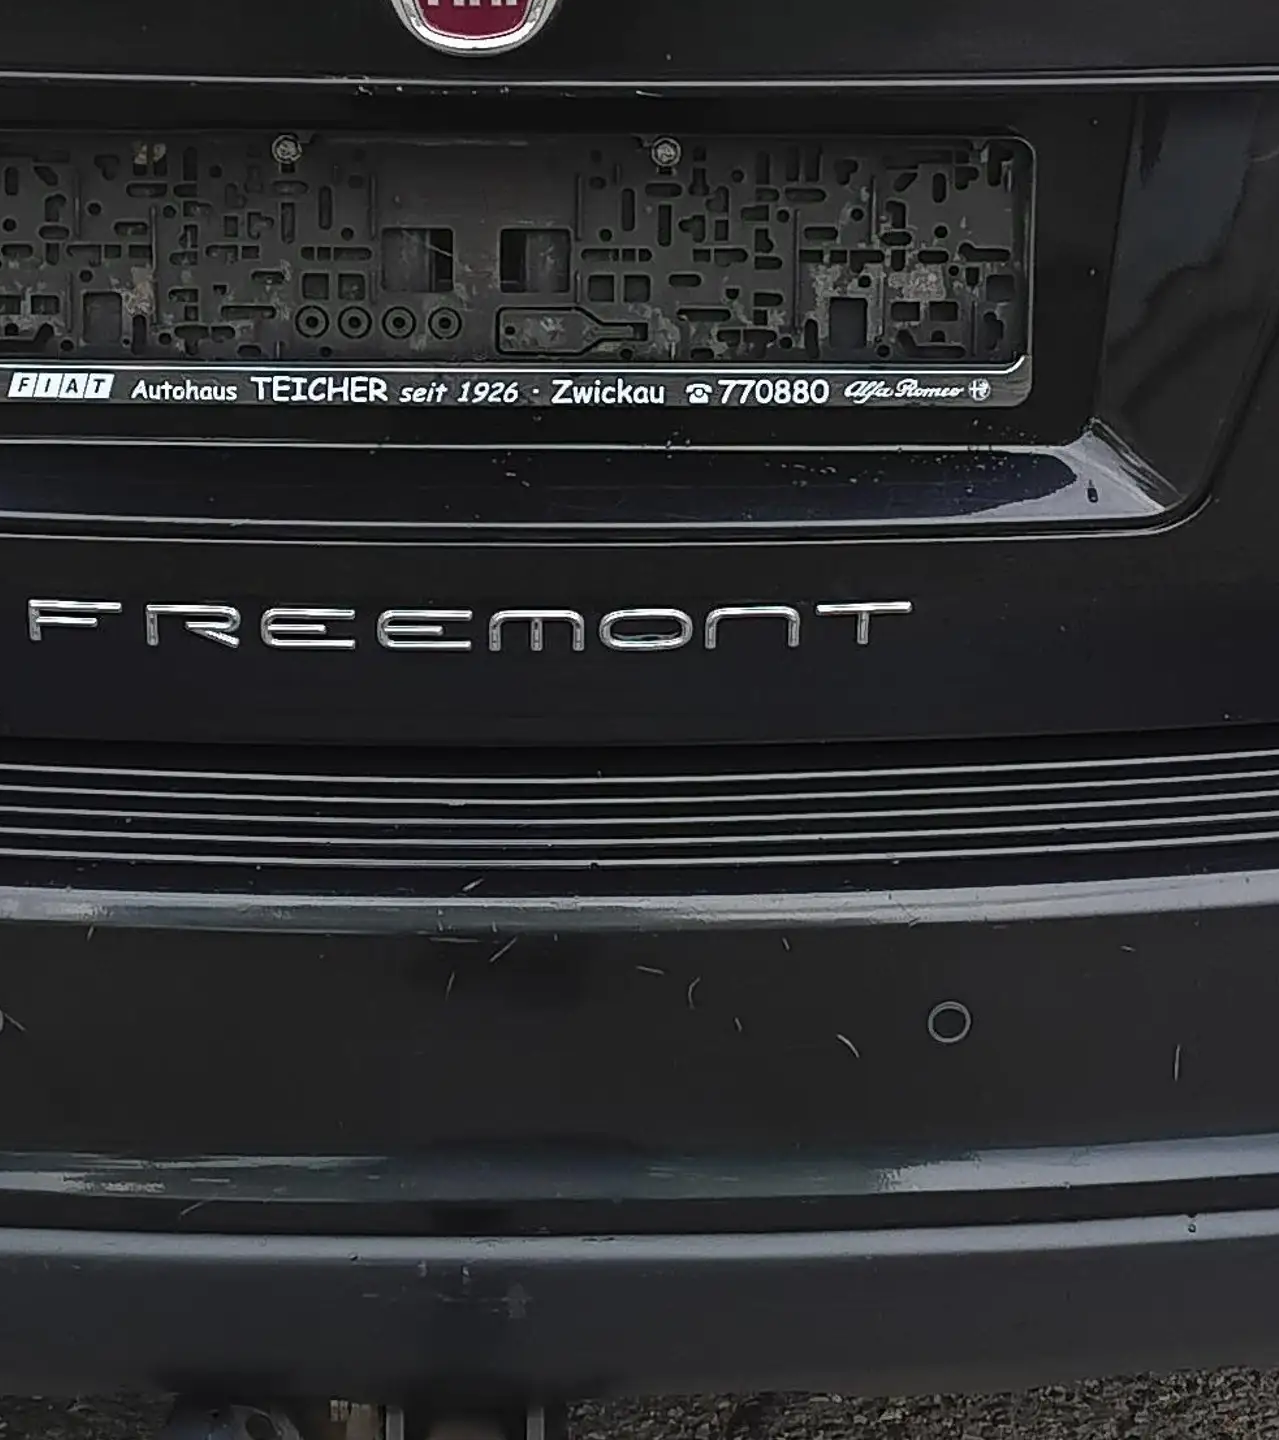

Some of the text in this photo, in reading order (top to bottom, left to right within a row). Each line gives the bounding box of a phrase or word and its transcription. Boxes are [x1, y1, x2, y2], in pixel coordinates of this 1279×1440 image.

[11, 374, 964, 406] FIAT Autohaus TEICHER seit 1926 Zwickau 770880 Alfa Romeo
[27, 598, 913, 652] FREEMONT
